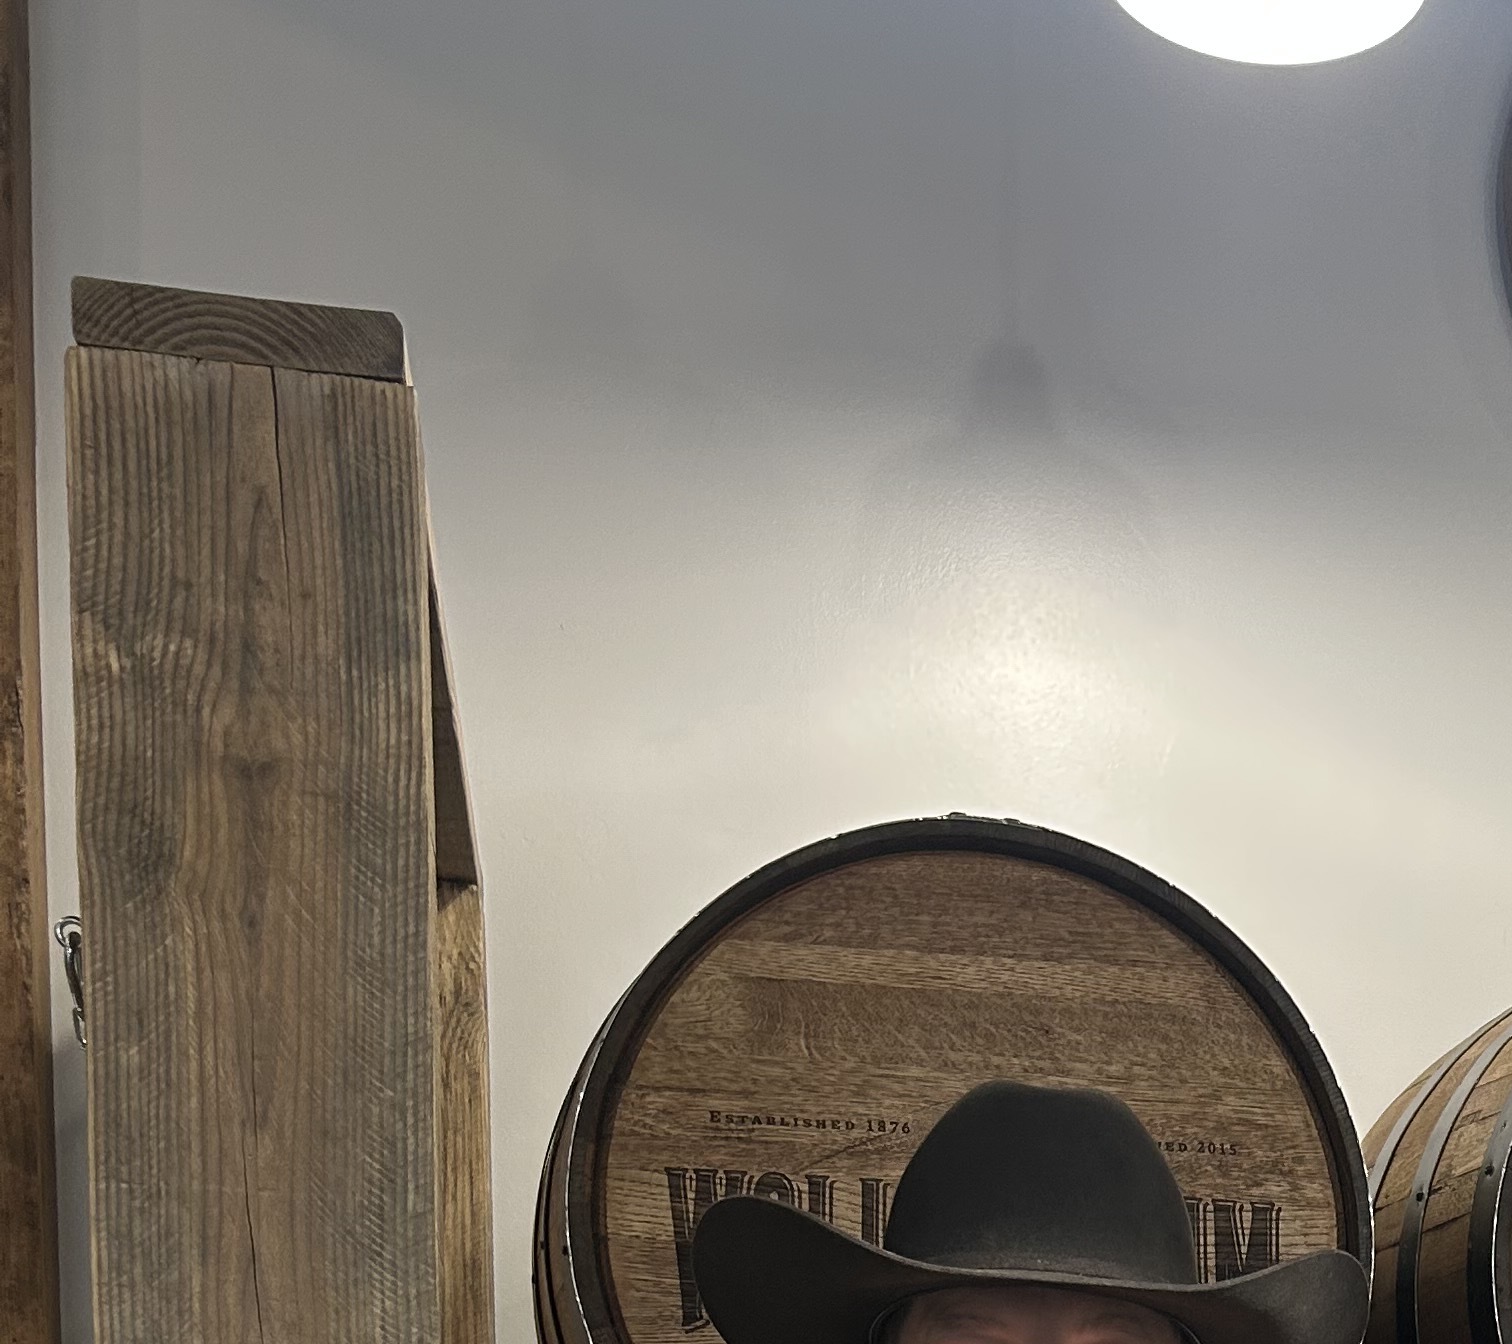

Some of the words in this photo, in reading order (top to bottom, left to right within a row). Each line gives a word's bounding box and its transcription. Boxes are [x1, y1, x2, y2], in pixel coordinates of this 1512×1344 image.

[708, 1110, 856, 1131] ESTABLISHED
[866, 1119, 912, 1135] 1876
[1197, 1142, 1238, 1156] 2015
